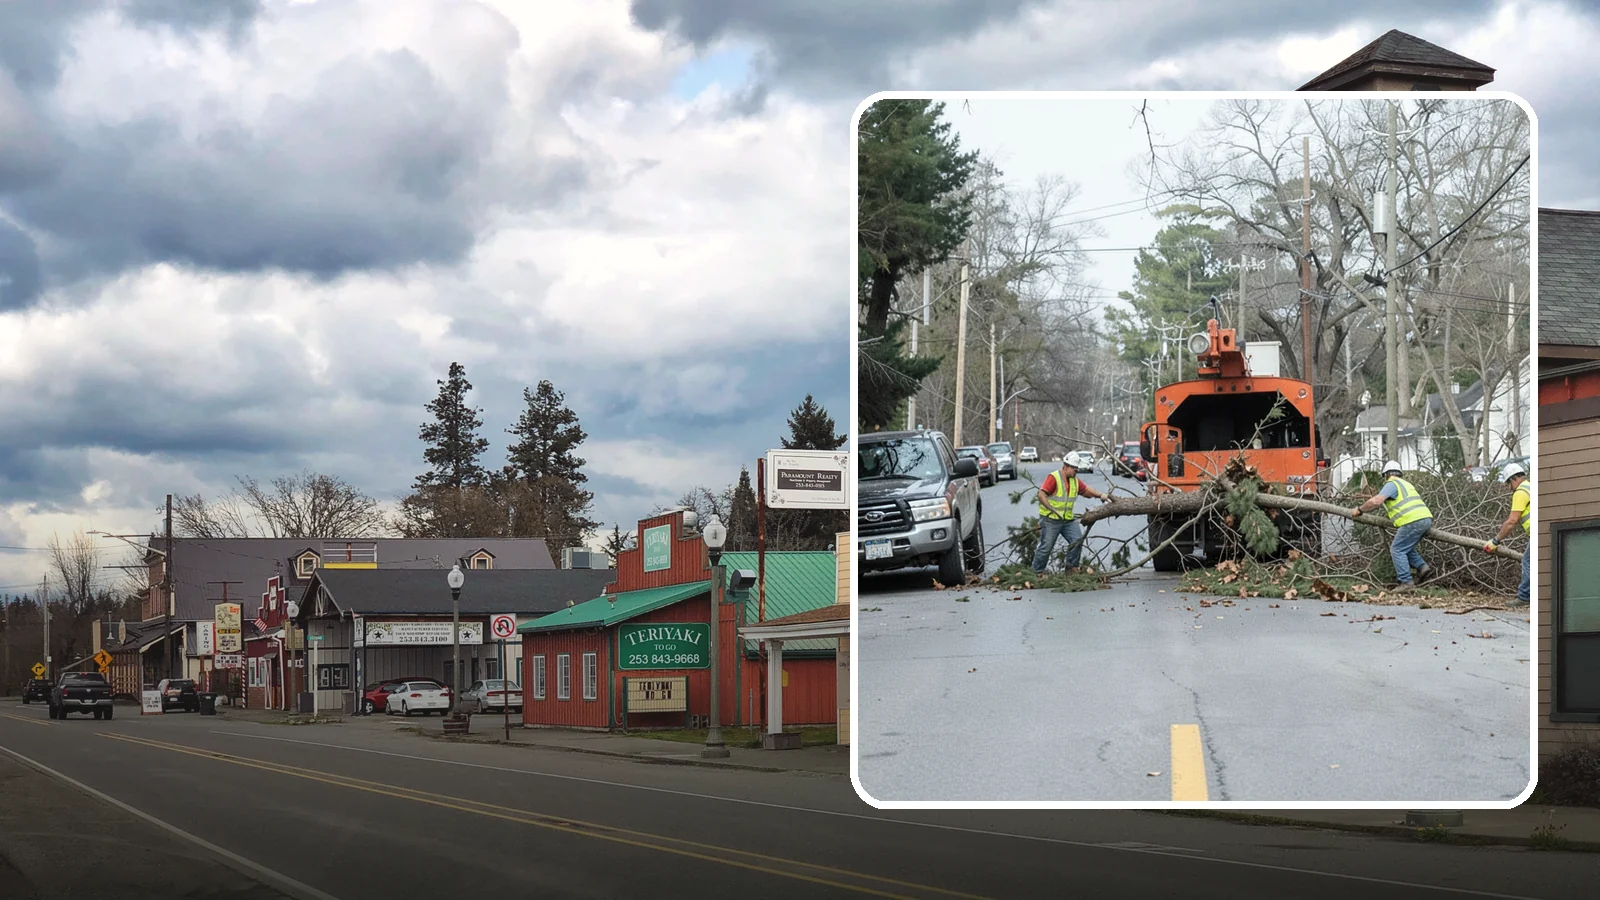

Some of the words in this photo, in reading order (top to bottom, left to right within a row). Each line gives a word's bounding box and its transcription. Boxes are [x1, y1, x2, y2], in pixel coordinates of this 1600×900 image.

[625, 628, 702, 646] TERIYAKI
[629, 655, 648, 664] 253
[652, 654, 700, 664] 843-9668
[639, 681, 672, 690] TERIYAKI
